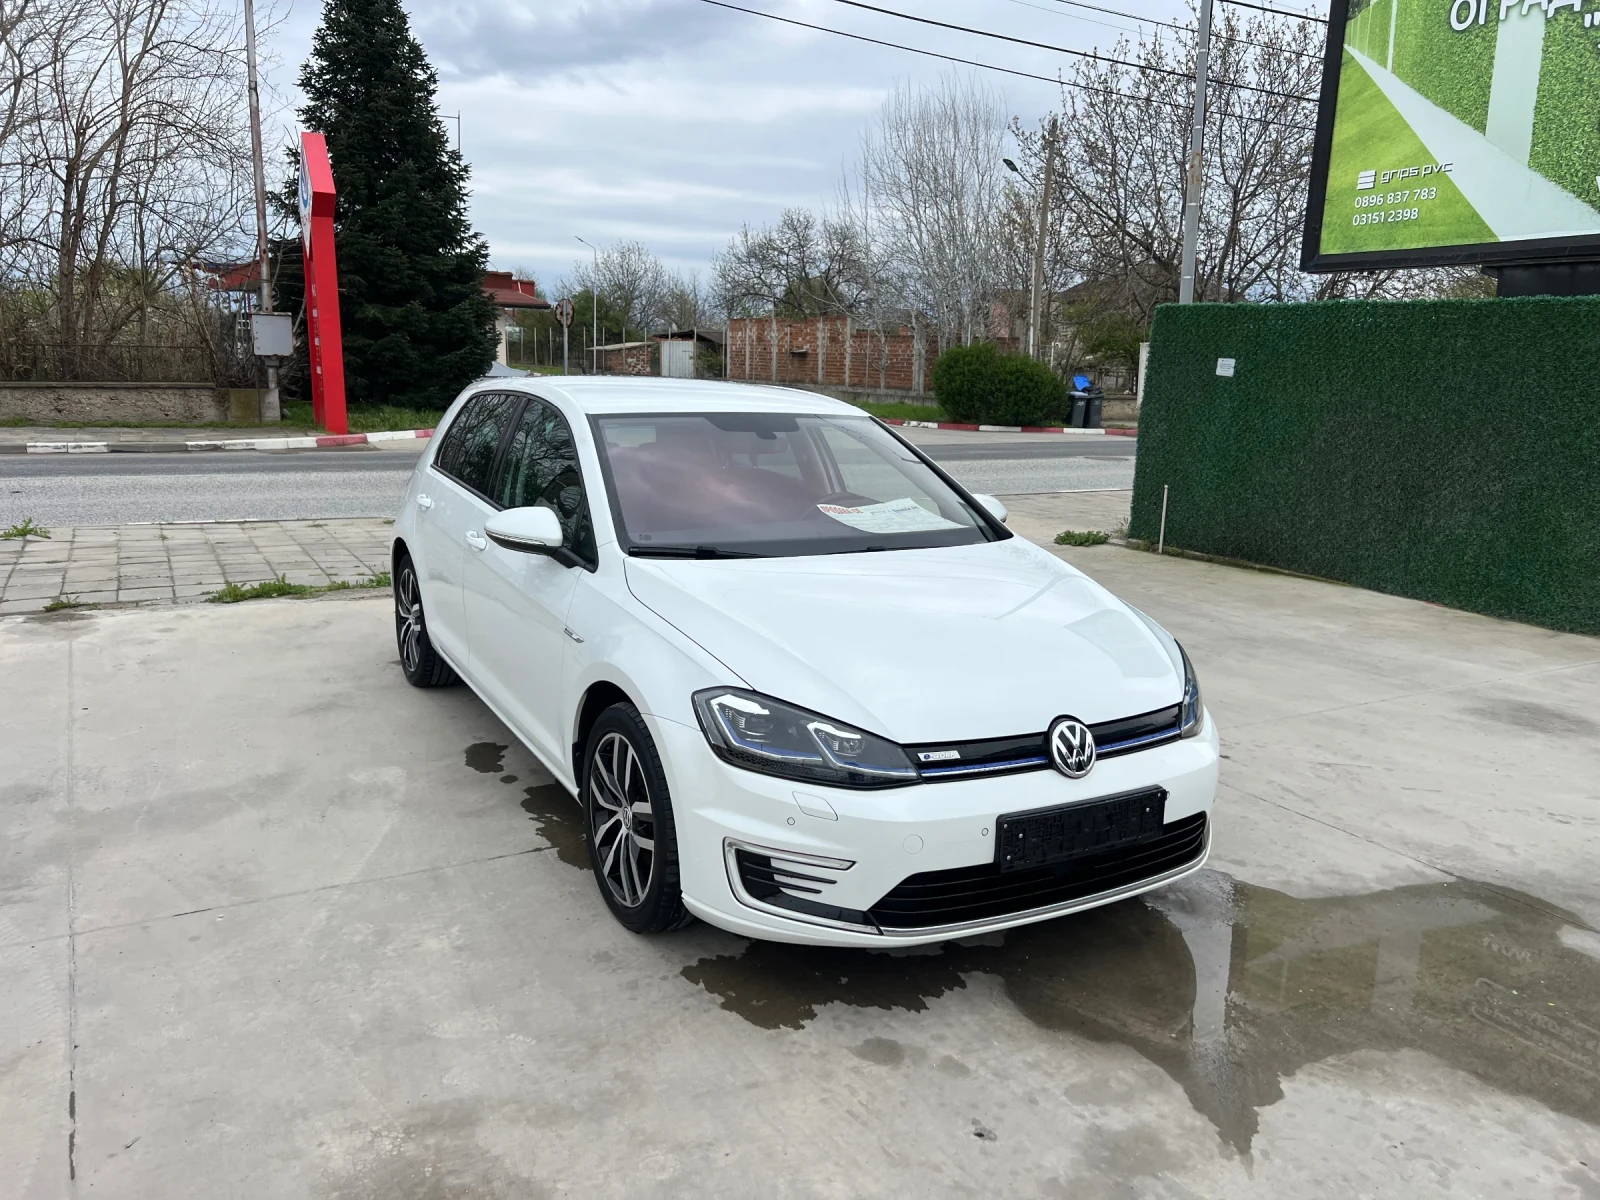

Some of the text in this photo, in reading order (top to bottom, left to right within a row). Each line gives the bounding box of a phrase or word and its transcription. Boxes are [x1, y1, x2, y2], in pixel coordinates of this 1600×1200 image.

[1381, 163, 1454, 184] grips pvc
[1355, 187, 1437, 208] 0896 837 783
[1352, 207, 1419, 226] 03151 2398
